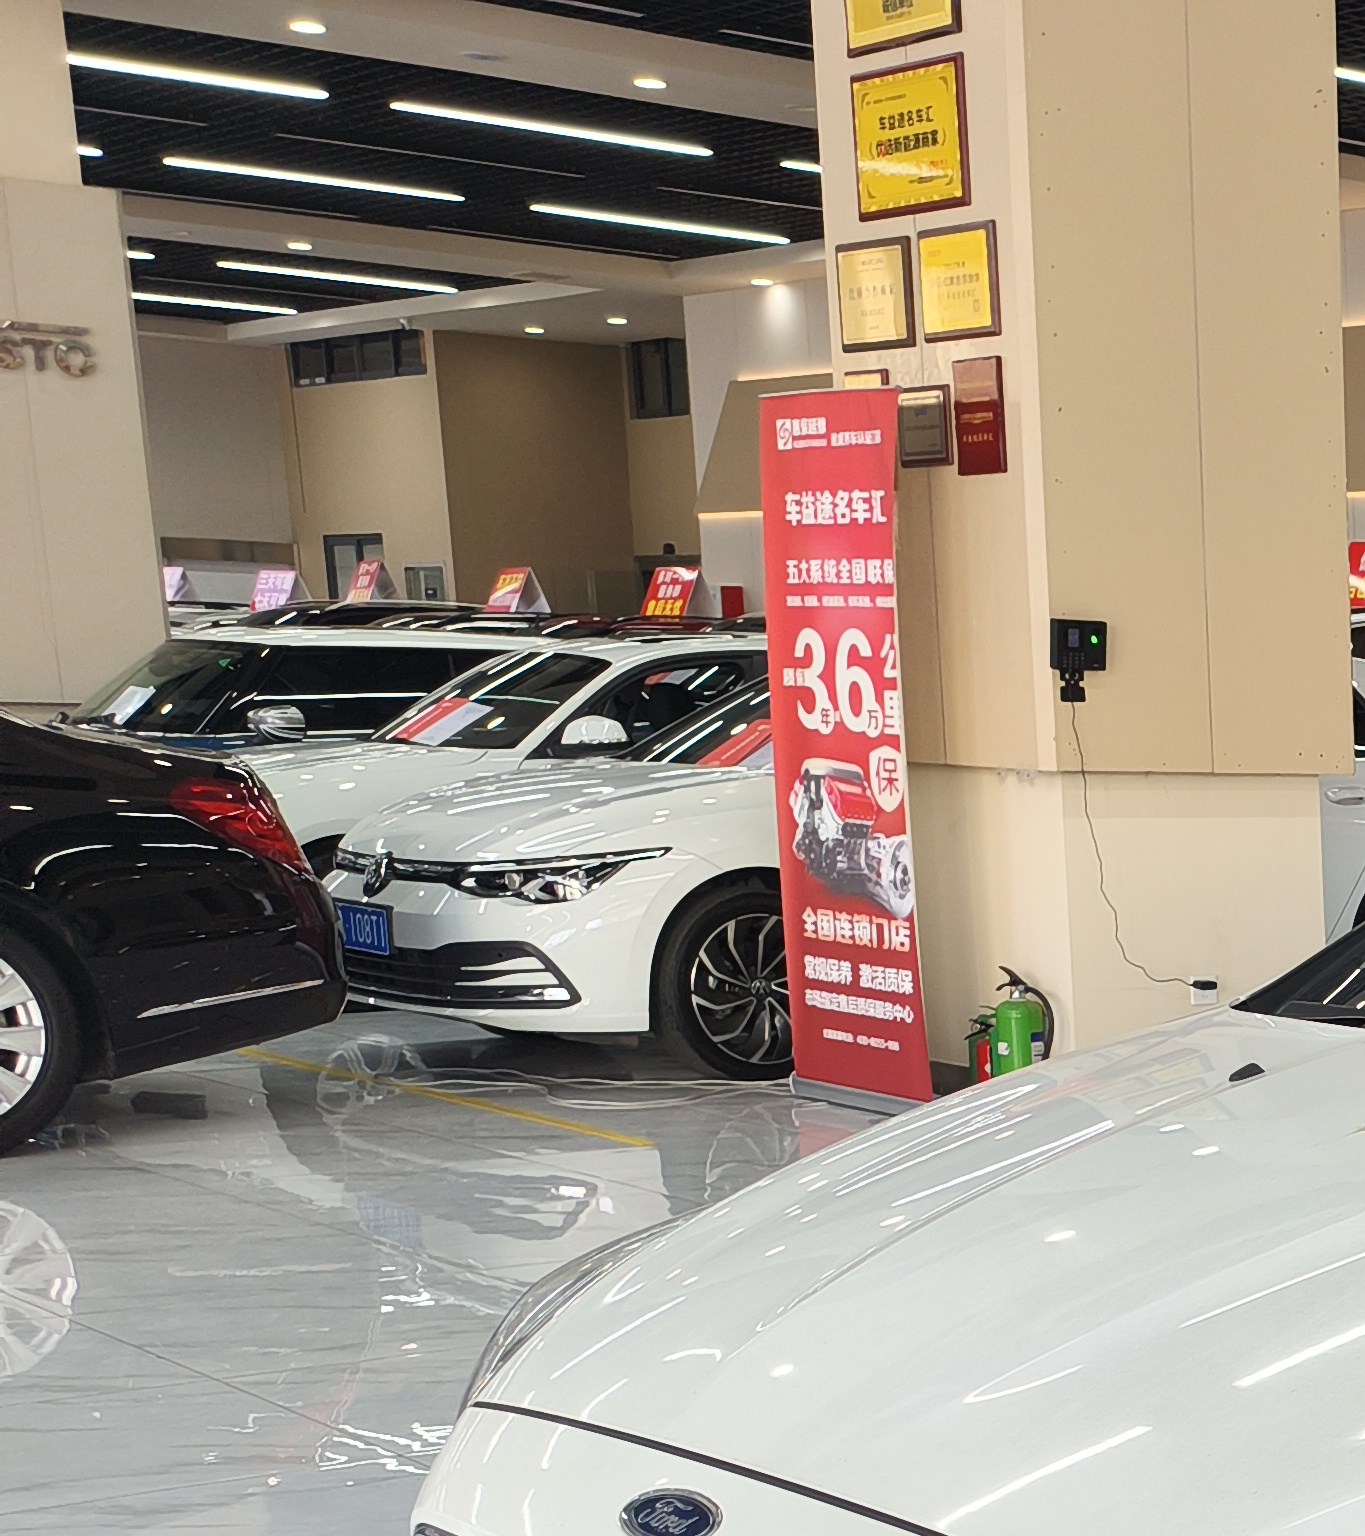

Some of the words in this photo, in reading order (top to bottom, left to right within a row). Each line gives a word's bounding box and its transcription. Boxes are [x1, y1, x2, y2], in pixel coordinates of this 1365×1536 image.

[785, 489, 888, 526] 车益途名车汇
[876, 756, 900, 797] 保
[802, 906, 911, 953] 全国连锁门店
[638, 1498, 700, 1535] Ford
